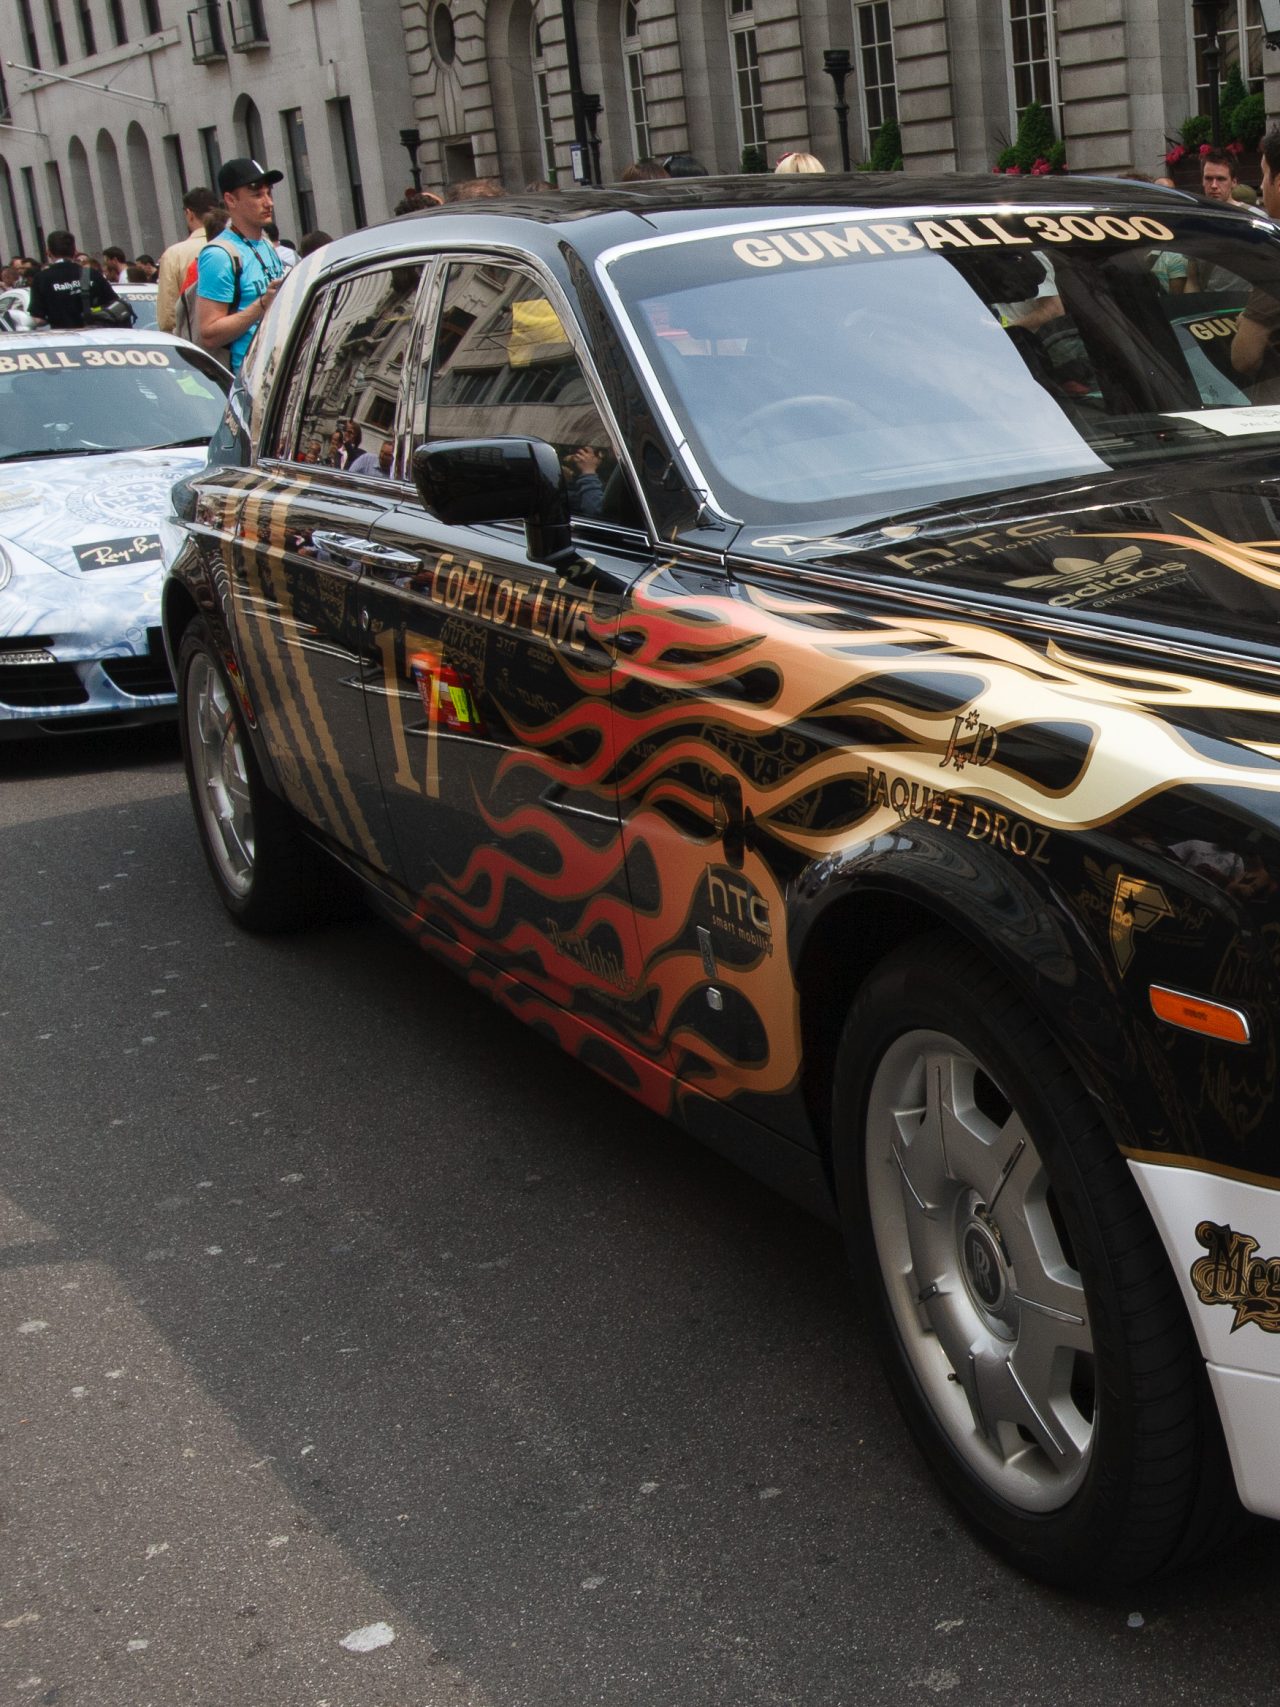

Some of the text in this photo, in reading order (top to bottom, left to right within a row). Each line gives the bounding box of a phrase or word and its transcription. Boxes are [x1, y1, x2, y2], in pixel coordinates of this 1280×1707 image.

[732, 215, 1176, 269] GUMBALL 3000
[81, 349, 170, 367] 3000
[80, 536, 161, 565] Ray-Ba
[912, 528, 1078, 577] smart mobility
[1047, 560, 1189, 607] adidas
[375, 627, 445, 799] 17
[866, 766, 1052, 866] JAQUET DROZ
[711, 914, 736, 937] smart
